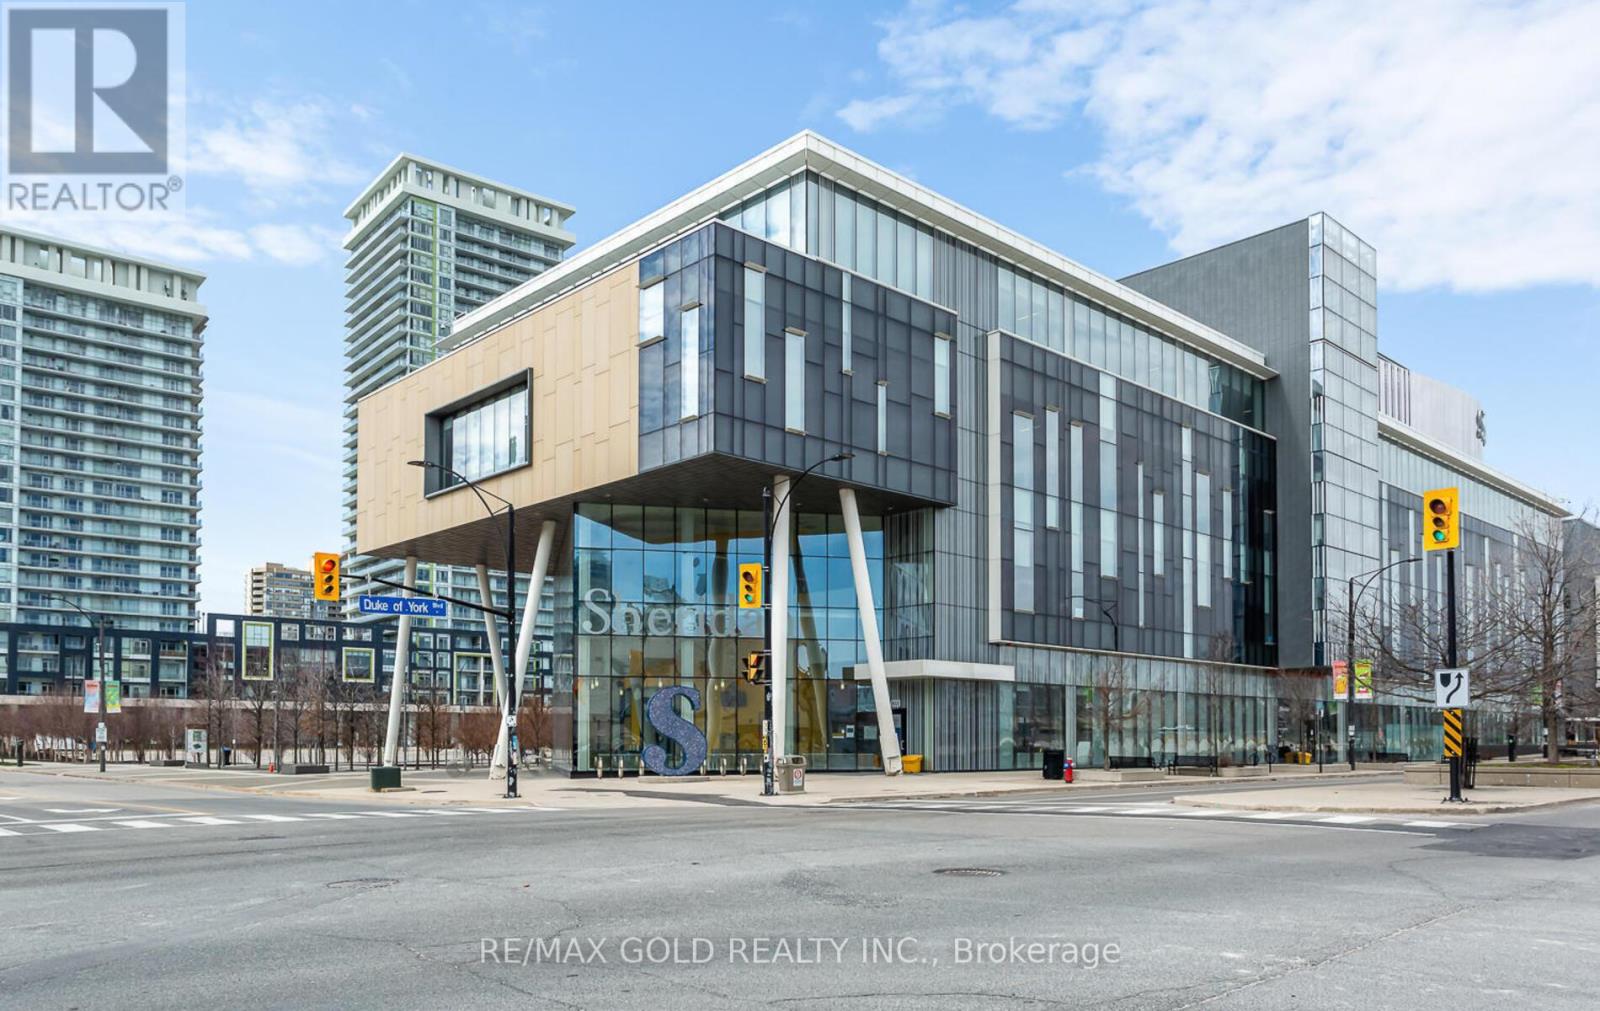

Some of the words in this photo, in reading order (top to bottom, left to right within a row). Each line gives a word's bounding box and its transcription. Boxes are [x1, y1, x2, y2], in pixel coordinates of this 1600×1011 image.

[363, 598, 389, 611] Duke
[393, 600, 403, 612] of
[408, 601, 429, 614] York
[641, 686, 708, 776] S
